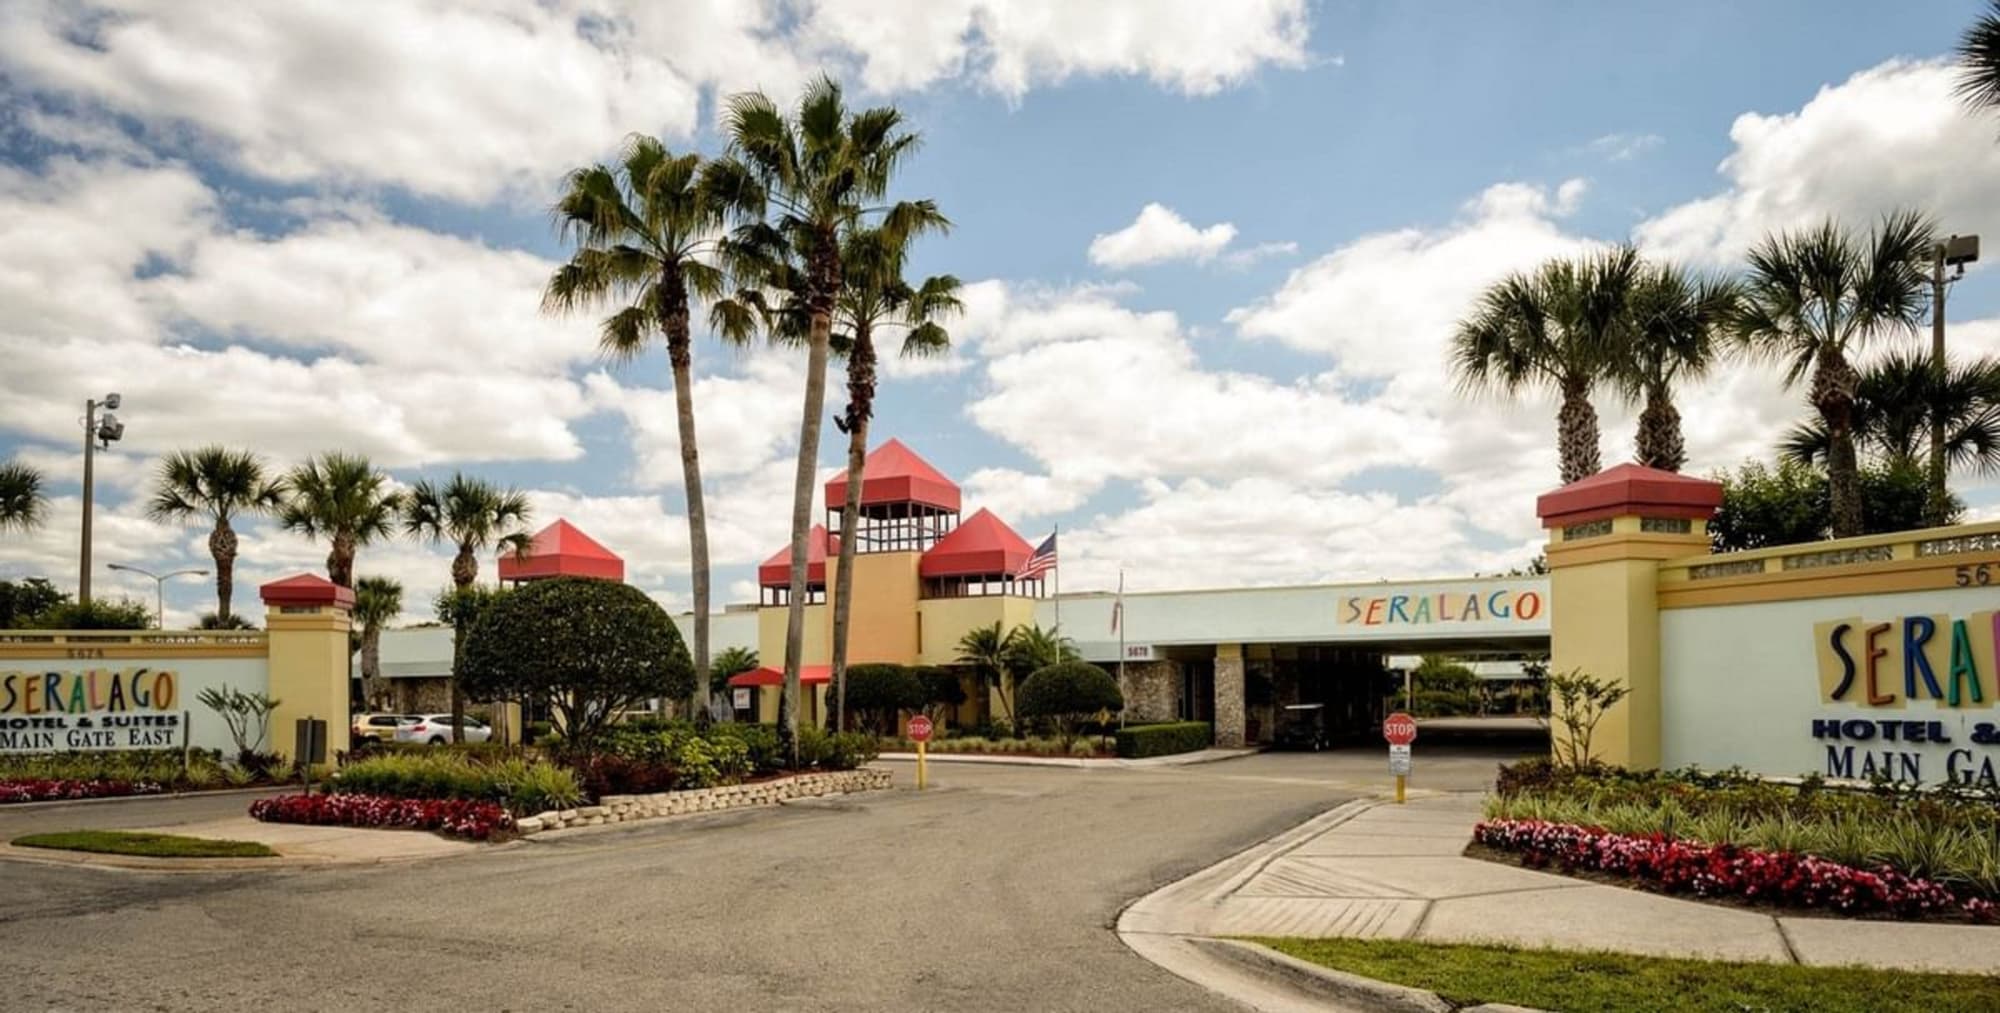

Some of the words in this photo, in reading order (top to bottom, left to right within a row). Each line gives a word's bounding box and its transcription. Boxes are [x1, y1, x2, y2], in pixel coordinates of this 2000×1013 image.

[1956, 563, 2000, 587] 56
[1346, 590, 1540, 626] SERALAGO
[0, 668, 173, 715] SERALAGO
[77, 717, 93, 729] &
[102, 715, 179, 728] SUITES
[1386, 723, 1415, 736] STOP
[1812, 719, 1952, 743] HOTEL
[1970, 722, 2000, 745] &
[0, 731, 55, 749] MAIN
[67, 729, 116, 748] GATE
[129, 728, 174, 746] EAST
[1826, 744, 1921, 784] MAIN
